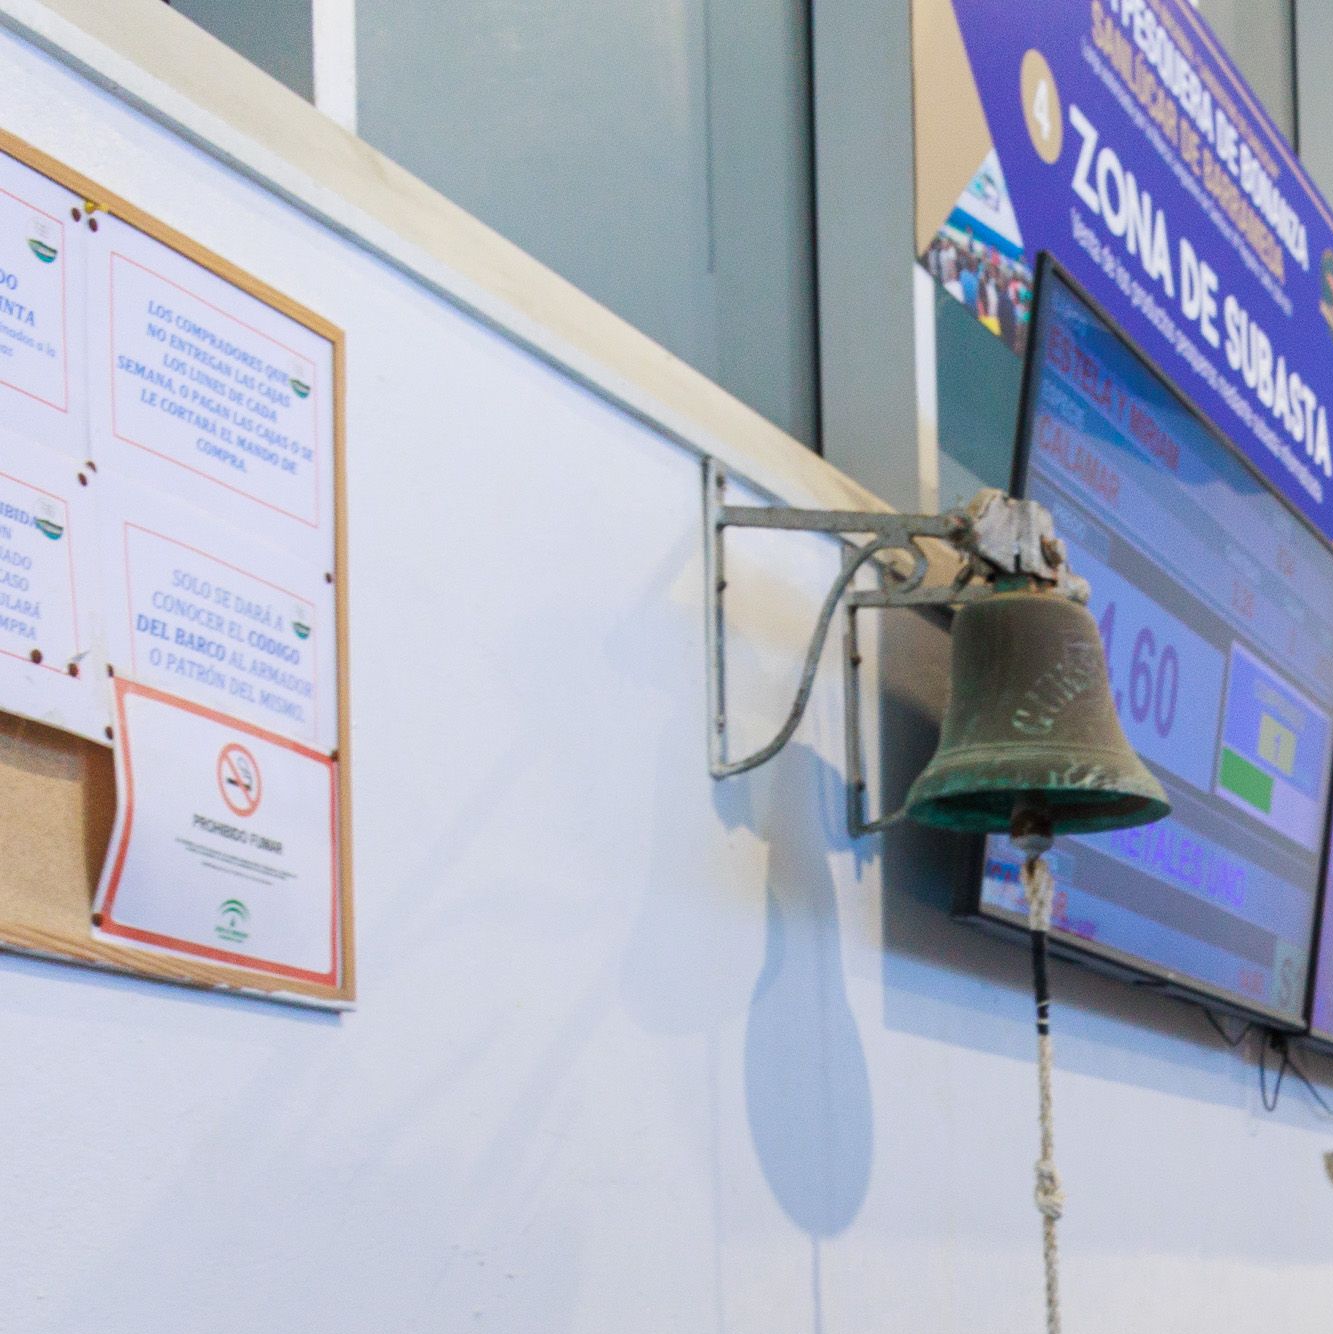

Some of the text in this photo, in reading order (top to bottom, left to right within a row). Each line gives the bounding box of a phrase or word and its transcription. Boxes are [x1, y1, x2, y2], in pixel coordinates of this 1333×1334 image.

[1033, 78, 1051, 141] 4
[1215, 108, 1239, 176] DE
[148, 301, 173, 323] LOS
[1069, 103, 1175, 298] ZONA
[1180, 237, 1219, 348] DE
[1224, 295, 1333, 478] SUBASTA
[147, 323, 166, 341] NO
[173, 569, 212, 599] SOLO
[214, 587, 231, 608] SE
[137, 613, 170, 641] DEL
[175, 628, 225, 662] BARCO
[229, 651, 246, 671] AL
[152, 590, 225, 634] CONOCER
[228, 621, 244, 643] EL
[150, 648, 161, 666] O
